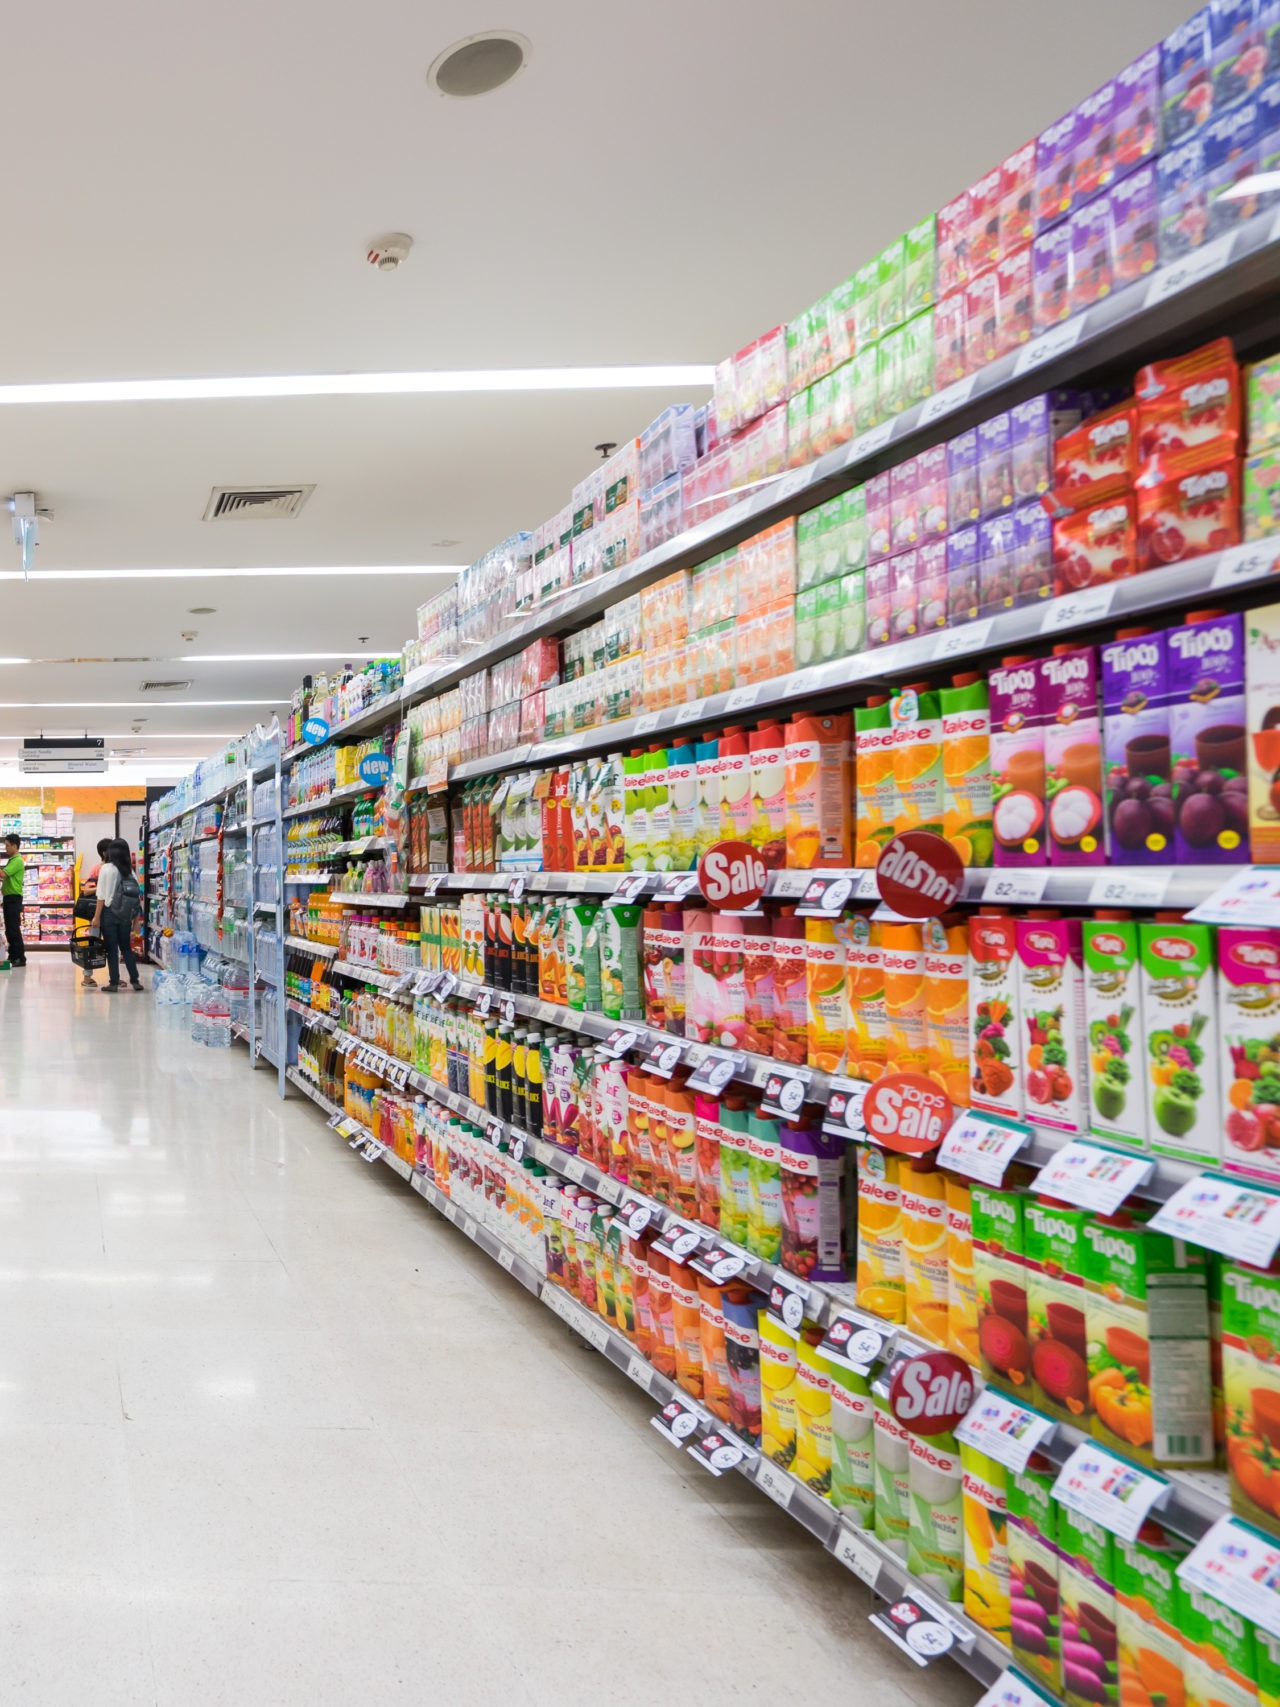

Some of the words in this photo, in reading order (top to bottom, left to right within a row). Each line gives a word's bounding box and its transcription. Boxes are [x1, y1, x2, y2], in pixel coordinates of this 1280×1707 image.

[1102, 644, 1160, 674] Tipco
[1169, 626, 1235, 660] Tipco
[989, 669, 1037, 695] Tipco
[1041, 658, 1090, 686] Tipco
[704, 851, 769, 901] Sale
[878, 839, 959, 907] ลดราคา
[995, 881, 1013, 896] 82
[1104, 884, 1125, 900] 82
[698, 934, 741, 949] Malee
[898, 1083, 946, 1109] Tops
[870, 1087, 942, 1143] Sale
[972, 1188, 1016, 1225] Tipco
[1025, 1208, 1077, 1243] Tipco
[1082, 1225, 1137, 1264] Tipco
[893, 1360, 971, 1421] Sale
[842, 1547, 857, 1566] 54
